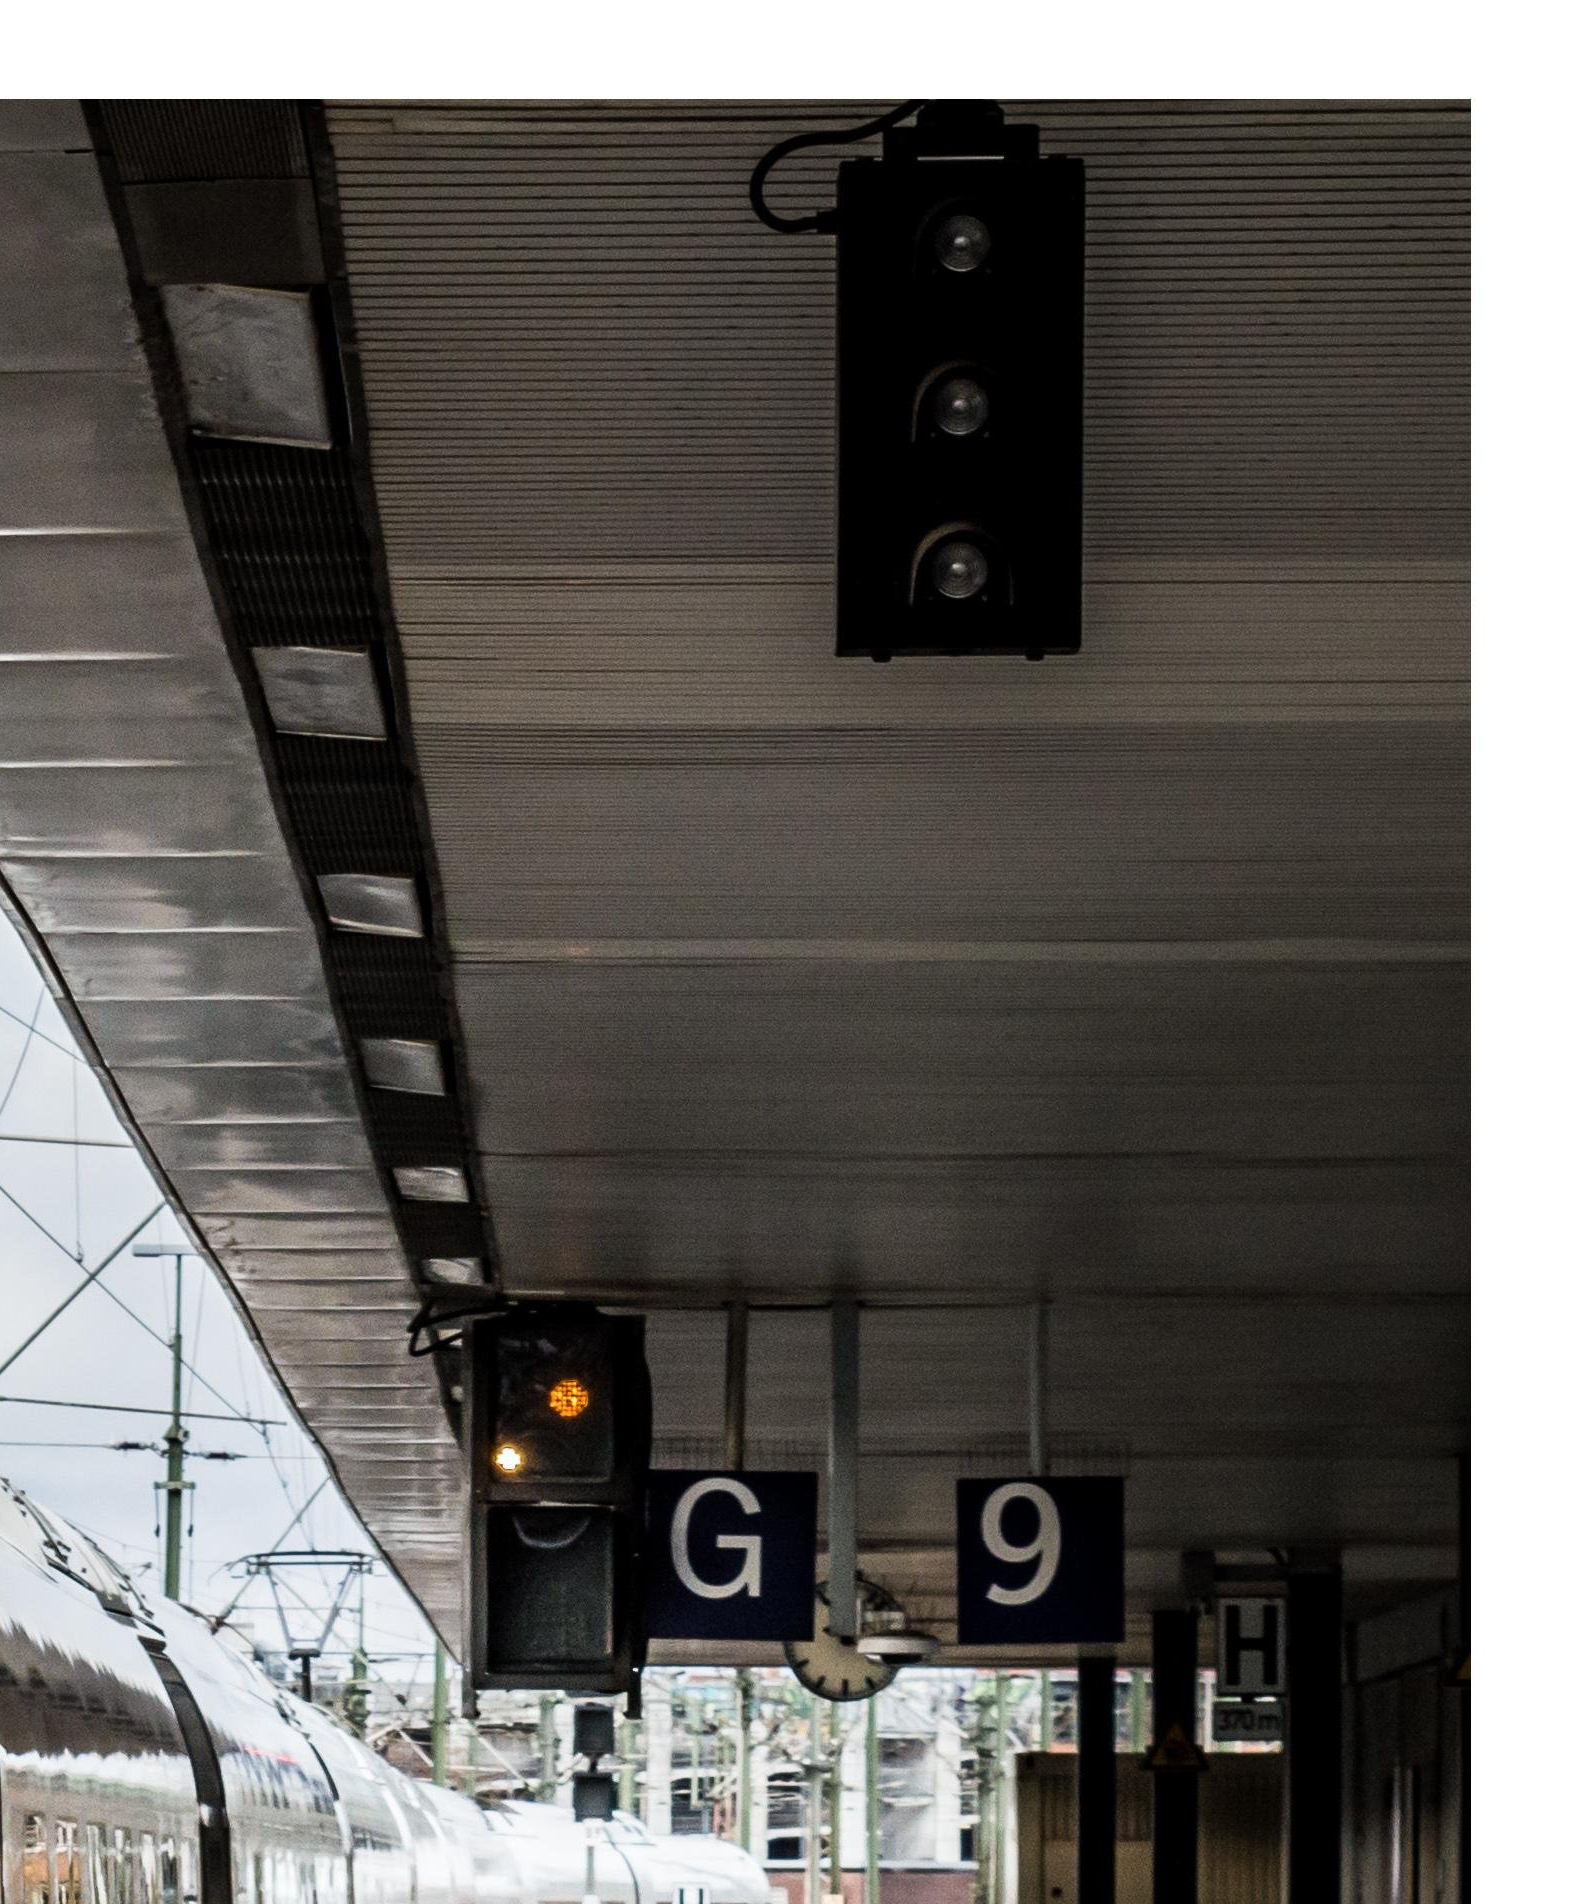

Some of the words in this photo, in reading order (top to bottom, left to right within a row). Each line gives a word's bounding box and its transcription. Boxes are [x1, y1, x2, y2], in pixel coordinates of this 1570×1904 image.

[670, 1477, 761, 1599] G
[980, 1482, 1061, 1606] 9
[1225, 1605, 1278, 1686] H
